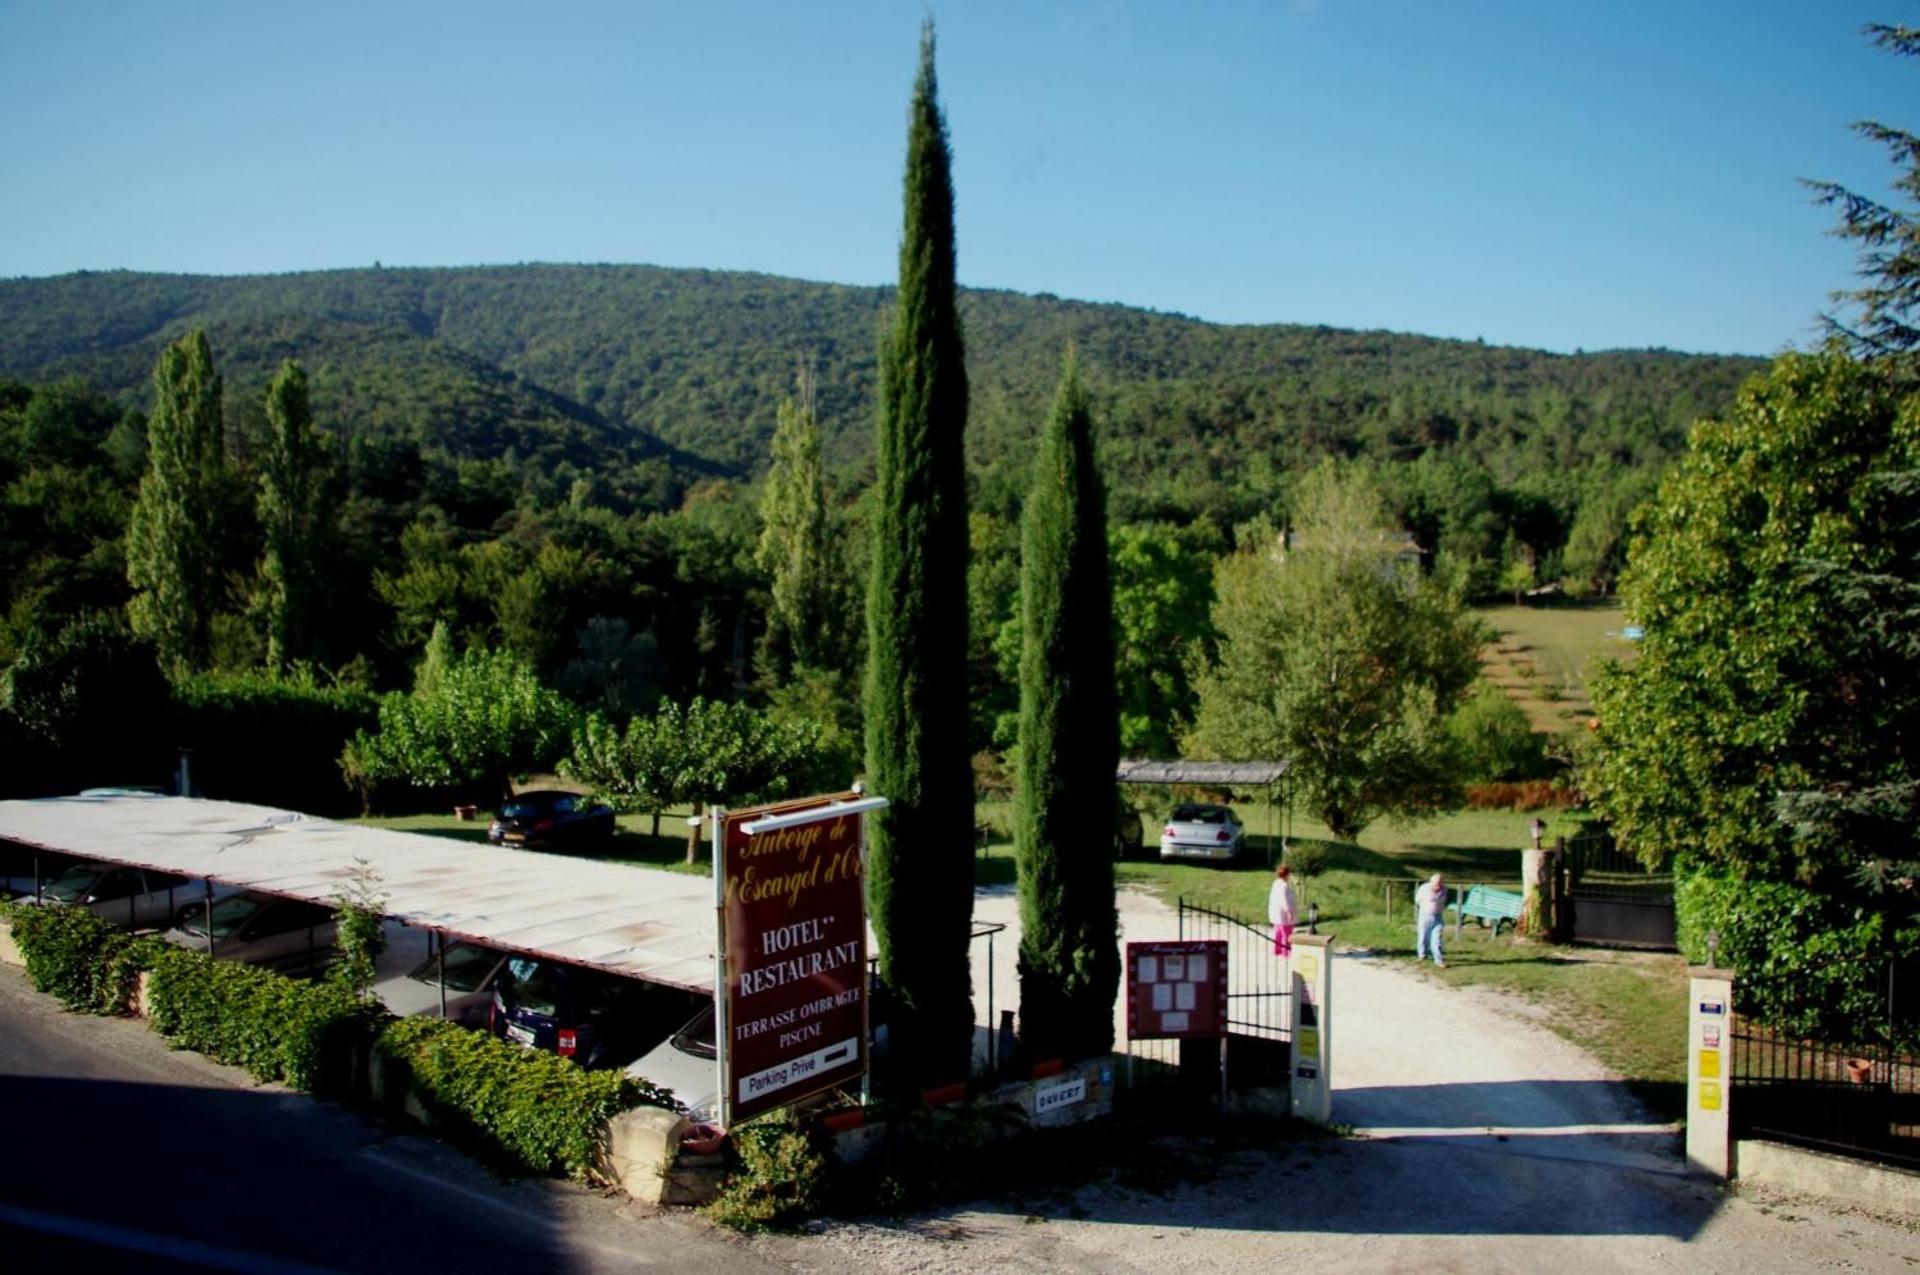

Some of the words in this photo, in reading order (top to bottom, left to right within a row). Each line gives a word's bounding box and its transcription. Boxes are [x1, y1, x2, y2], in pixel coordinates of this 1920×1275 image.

[739, 826, 822, 863] Auberge
[829, 815, 847, 841] de
[740, 941, 859, 997] RESTAURANT
[735, 1009, 797, 1040] TERRASSE
[779, 1022, 822, 1048] PISCINE
[749, 1069, 788, 1093] Parking
